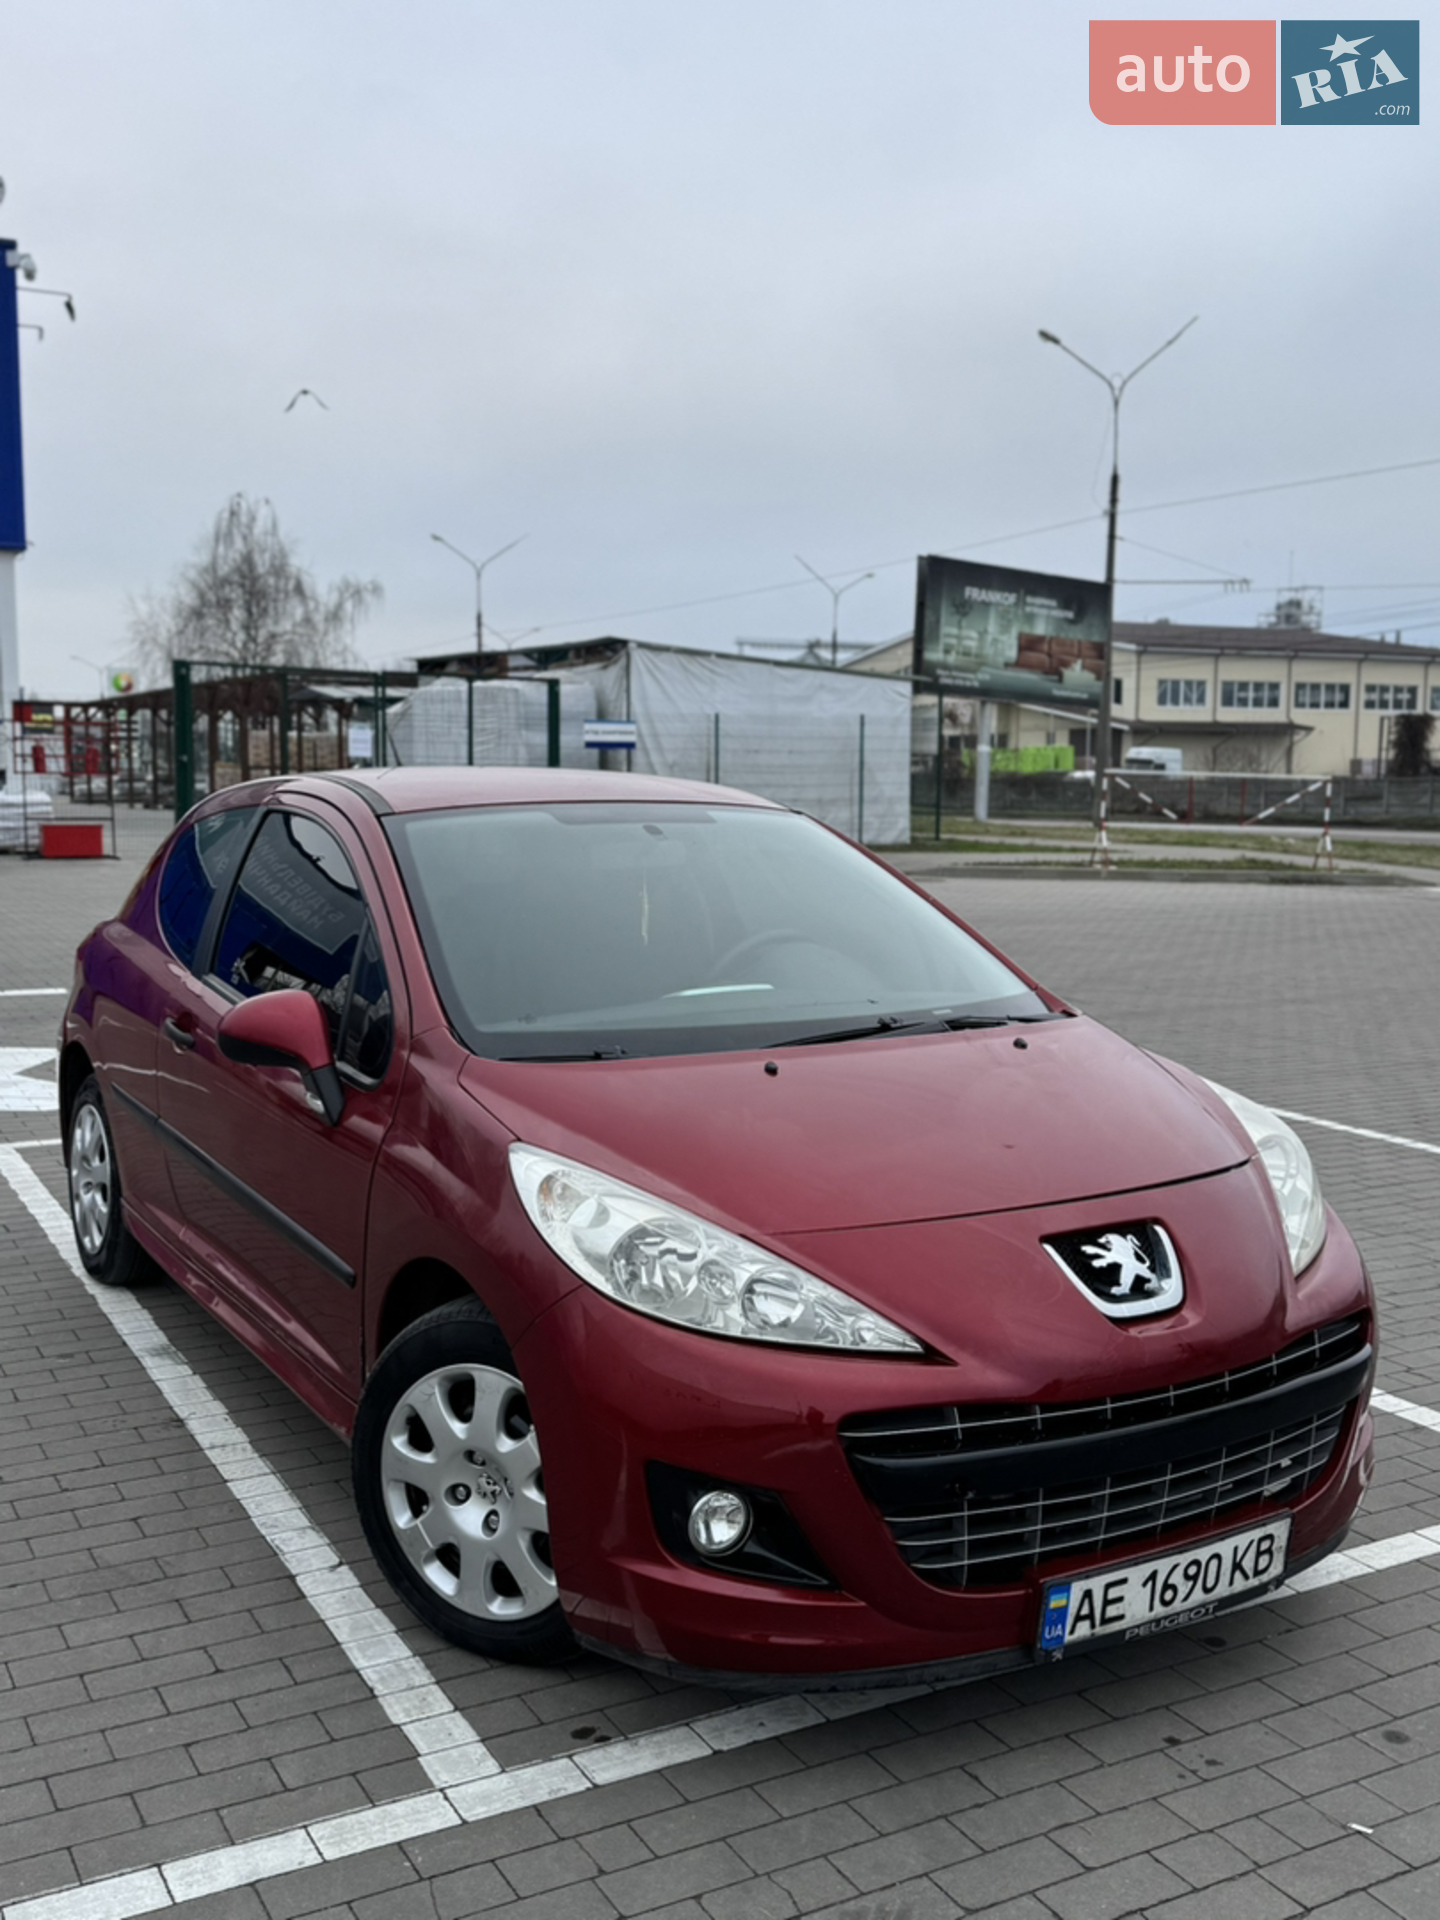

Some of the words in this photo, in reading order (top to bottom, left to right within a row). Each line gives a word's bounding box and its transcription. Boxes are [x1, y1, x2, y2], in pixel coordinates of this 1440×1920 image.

[964, 586, 1018, 605] FRANKOF
[1068, 1576, 1129, 1637] AE
[1141, 1553, 1223, 1614] 1690
[1228, 1533, 1276, 1588] KB
[1044, 1623, 1064, 1640] UA
[1124, 1602, 1219, 1641] PEUGEOT
